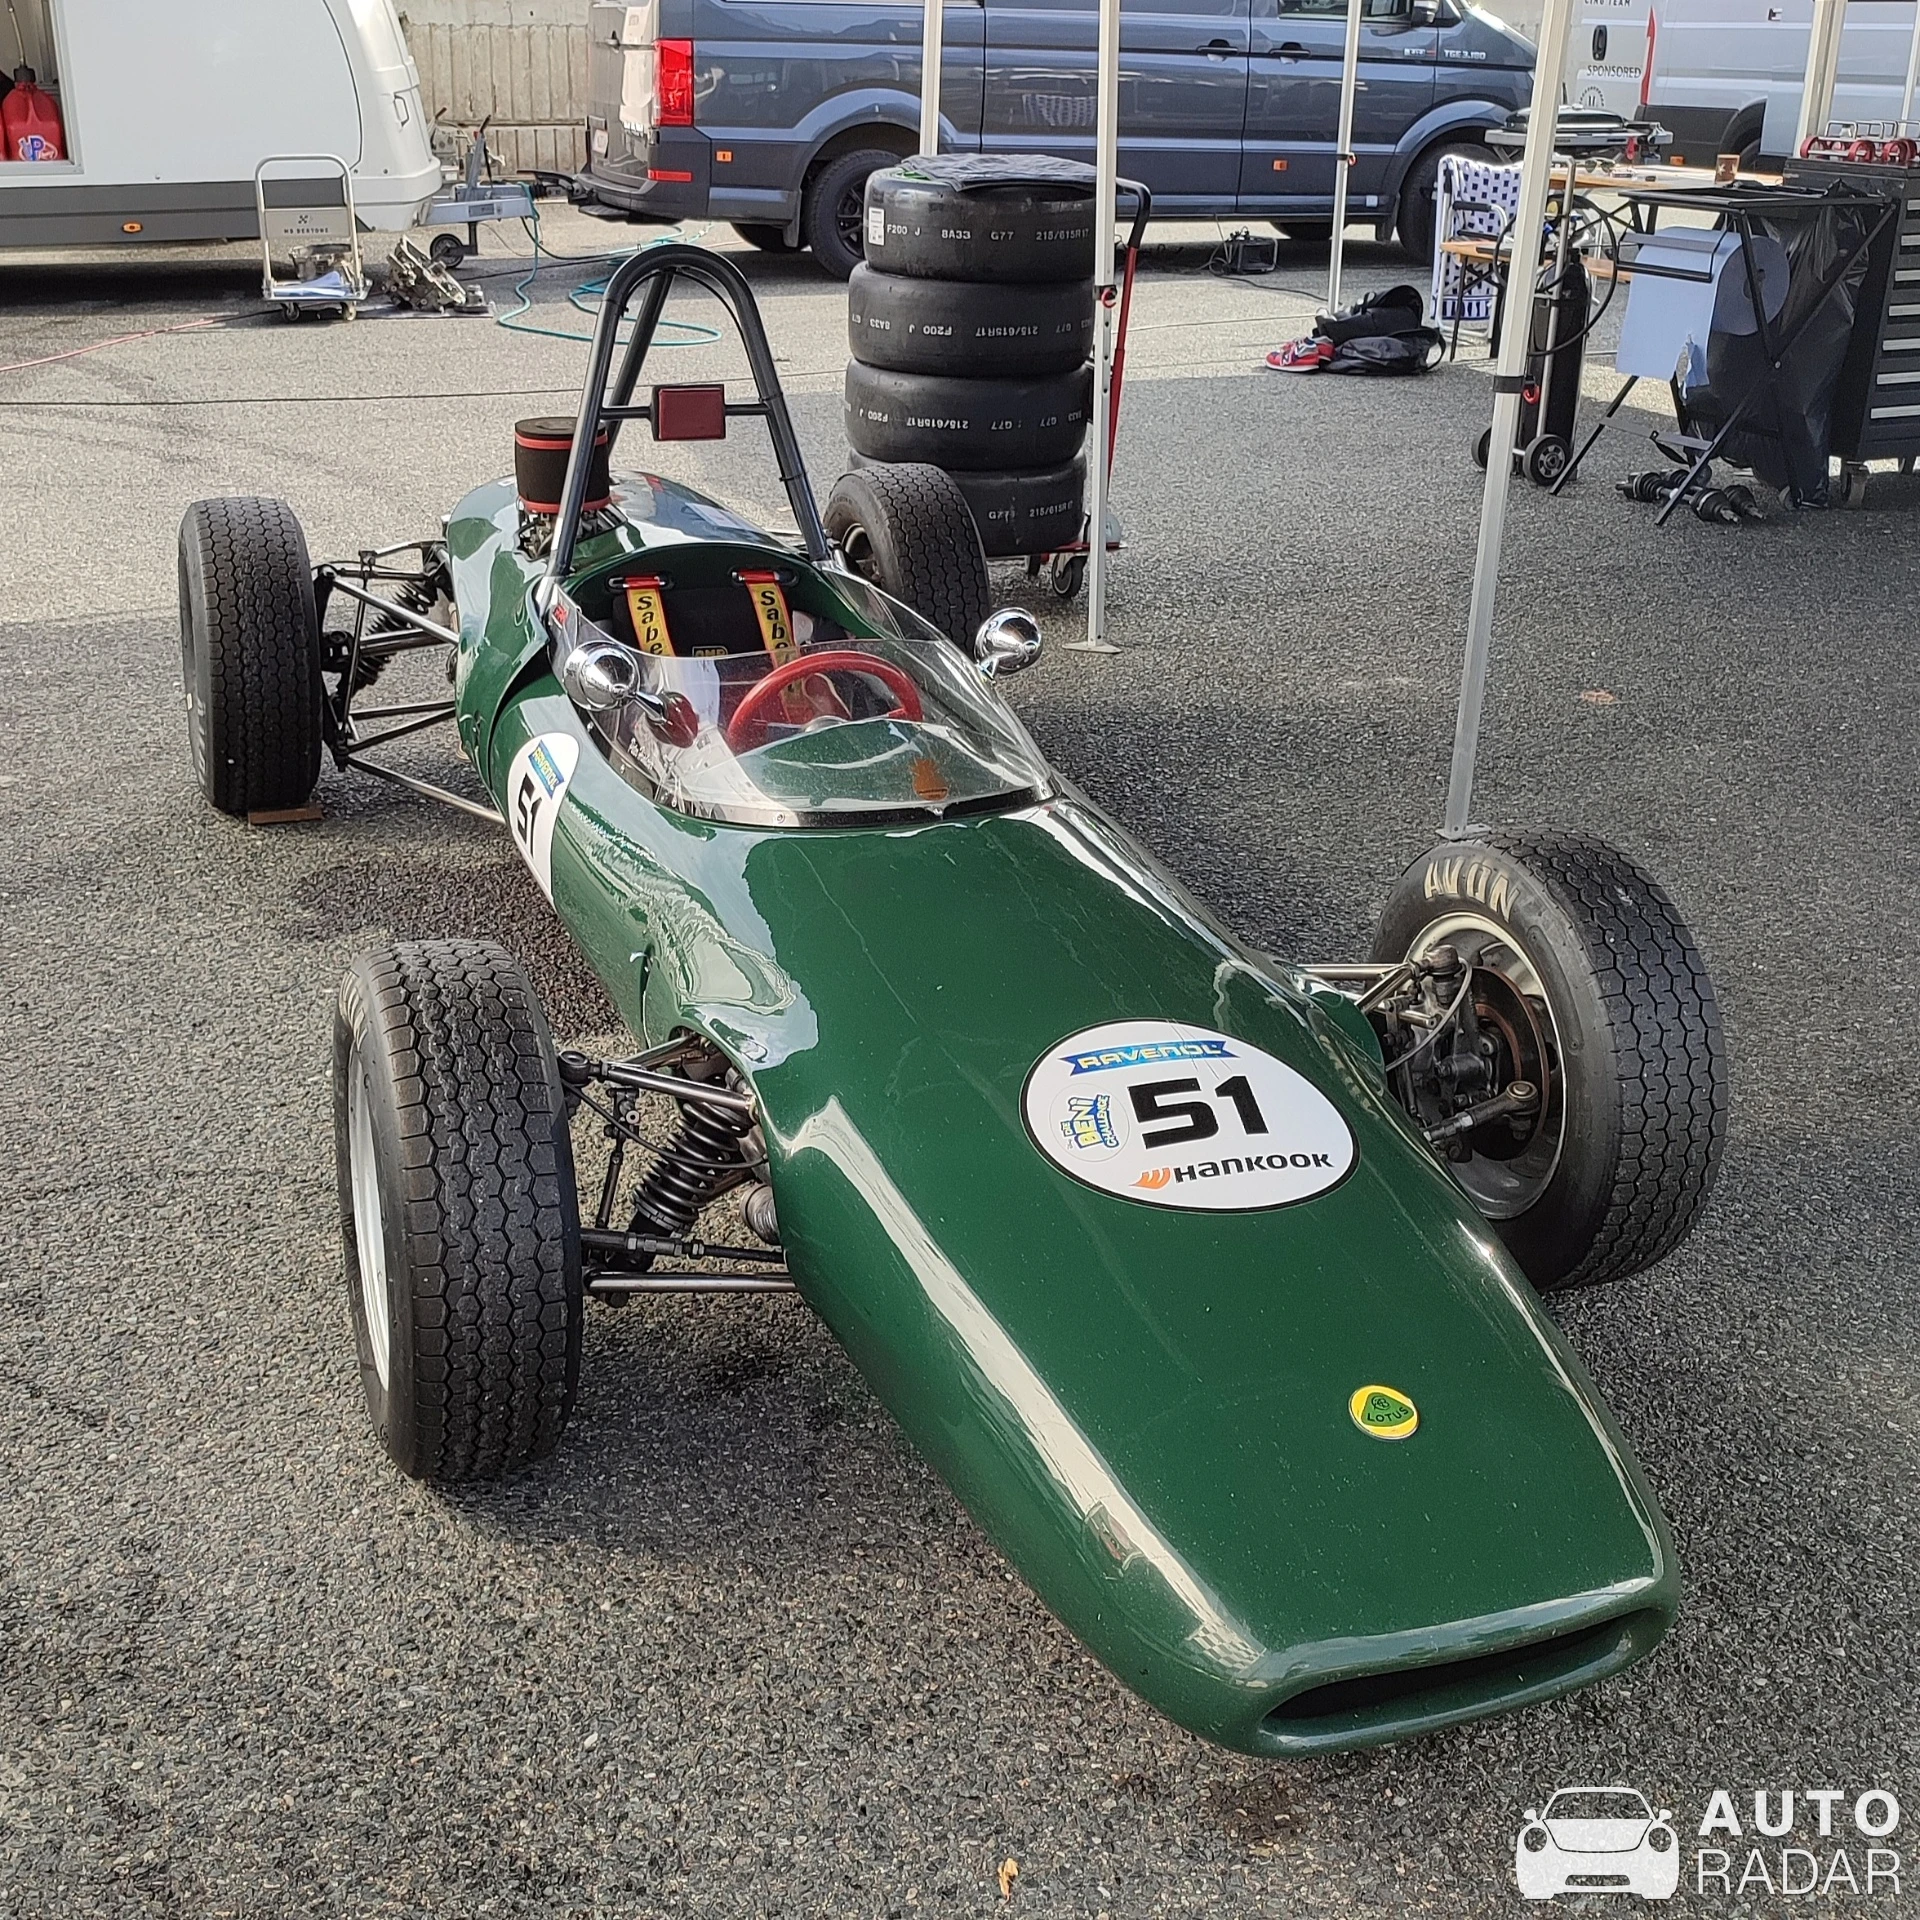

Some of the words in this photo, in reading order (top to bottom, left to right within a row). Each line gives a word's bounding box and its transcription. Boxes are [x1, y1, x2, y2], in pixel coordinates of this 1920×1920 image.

[1587, 65, 1642, 78] SPONSORED
[887, 224, 907, 235] F200
[914, 227, 921, 236] J
[941, 229, 971, 240] 8A33
[990, 231, 1014, 241] G77
[909, 323, 915, 333] J
[923, 325, 952, 336] F200
[517, 772, 542, 859] 51
[1423, 858, 1521, 924] AVON
[1077, 1043, 1222, 1069] RAVENOL
[1128, 1075, 1269, 1150] 51
[1367, 1406, 1409, 1422] LOTUS
